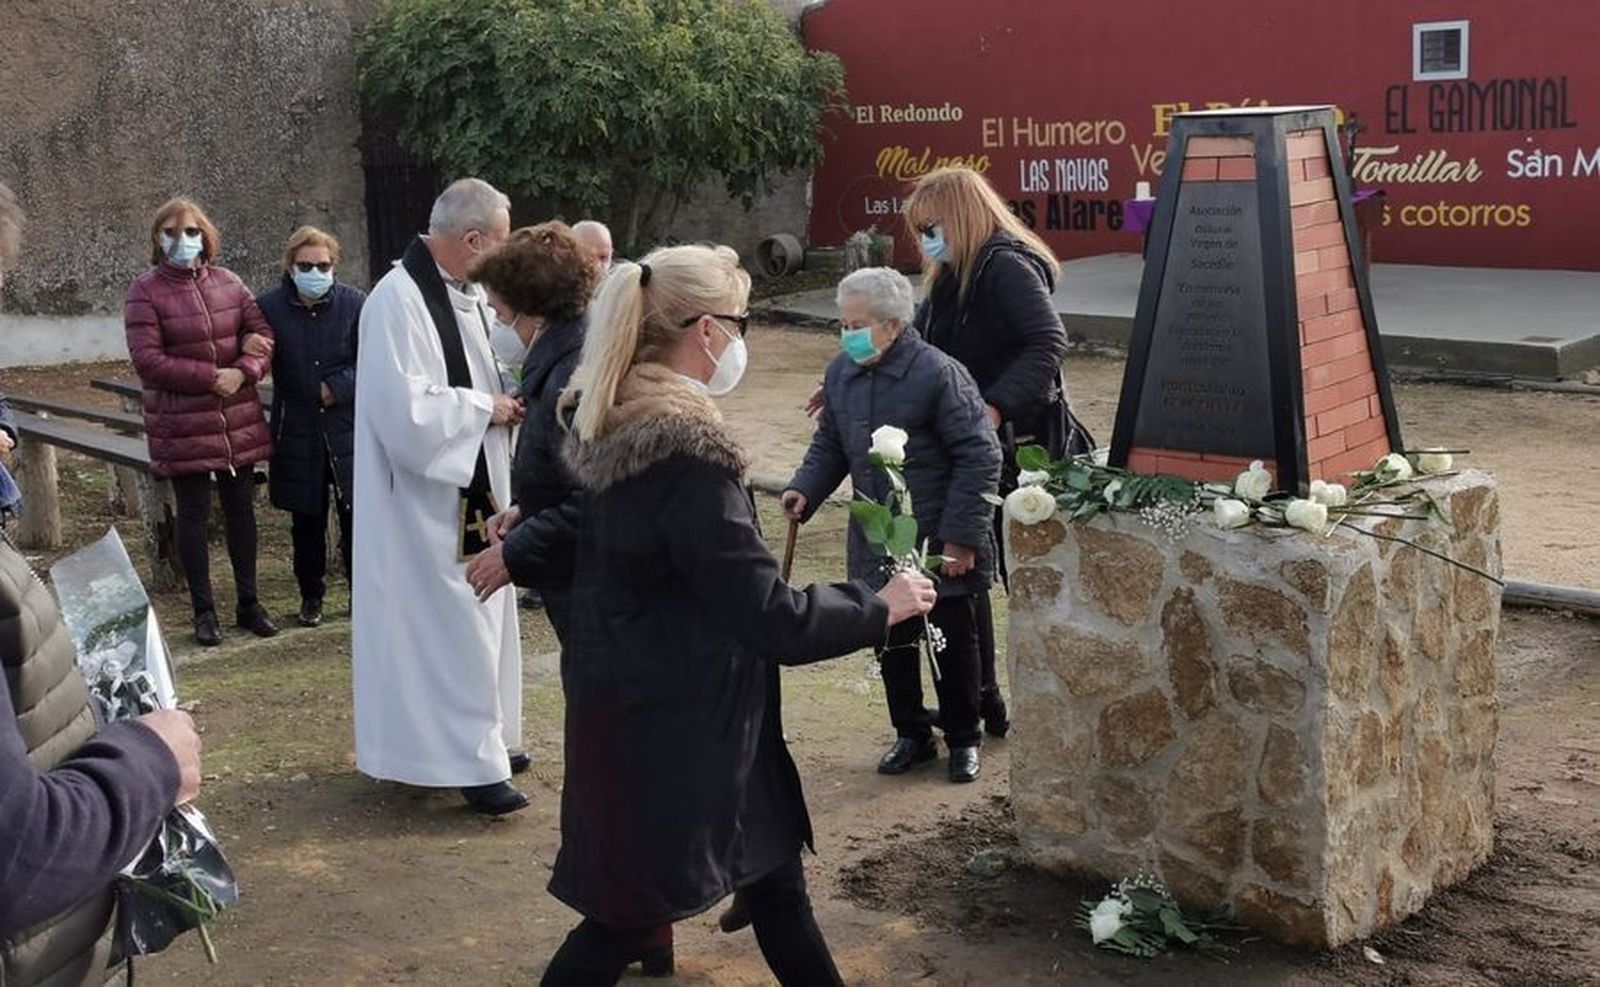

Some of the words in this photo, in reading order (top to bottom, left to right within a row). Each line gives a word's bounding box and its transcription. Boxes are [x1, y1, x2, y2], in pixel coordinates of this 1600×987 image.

[856, 105, 874, 123] El
[880, 102, 963, 122] Redondo
[1385, 84, 1417, 134] EL
[1429, 76, 1577, 133] GAMONAL
[982, 119, 1003, 147] El
[1013, 117, 1126, 147] Humero
[876, 145, 931, 181] Mal
[1020, 159, 1050, 192] LAS
[1055, 157, 1109, 192] NAVAS
[1131, 143, 1165, 176] Ve
[1351, 145, 1482, 183] Tomillar
[1573, 147, 1600, 177] M
[865, 196, 889, 214] Las
[1046, 193, 1123, 231] Alare
[1400, 200, 1531, 227] cotorros
